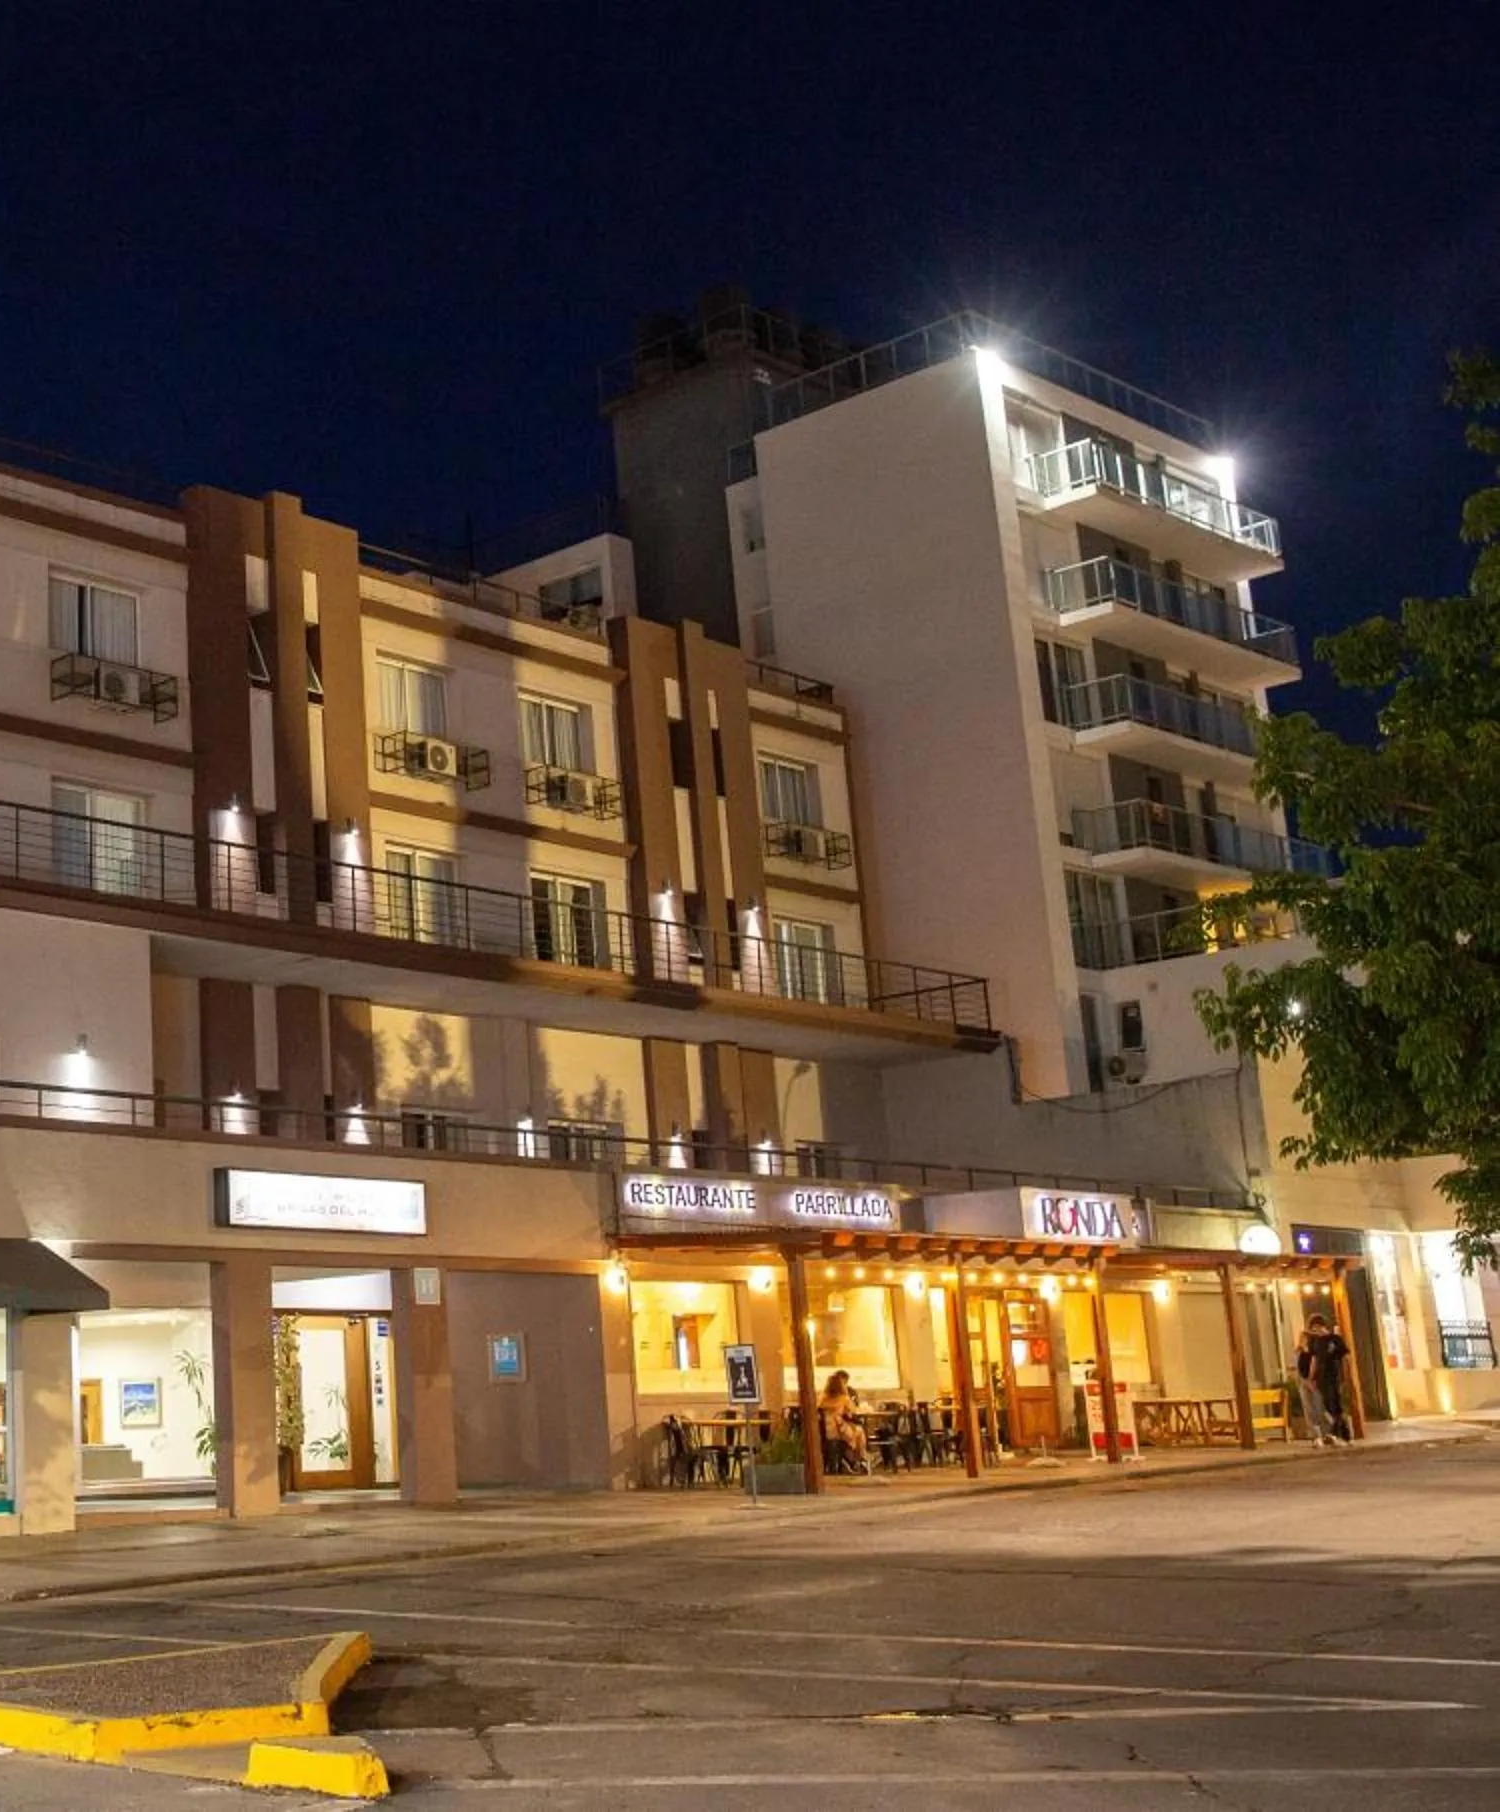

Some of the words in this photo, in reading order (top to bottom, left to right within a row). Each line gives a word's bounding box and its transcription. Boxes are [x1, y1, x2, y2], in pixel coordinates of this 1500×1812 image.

[630, 1182, 757, 1210] RESTAURANTE
[795, 1193, 893, 1219] PARRILLADA
[1040, 1197, 1127, 1239] RONDA
